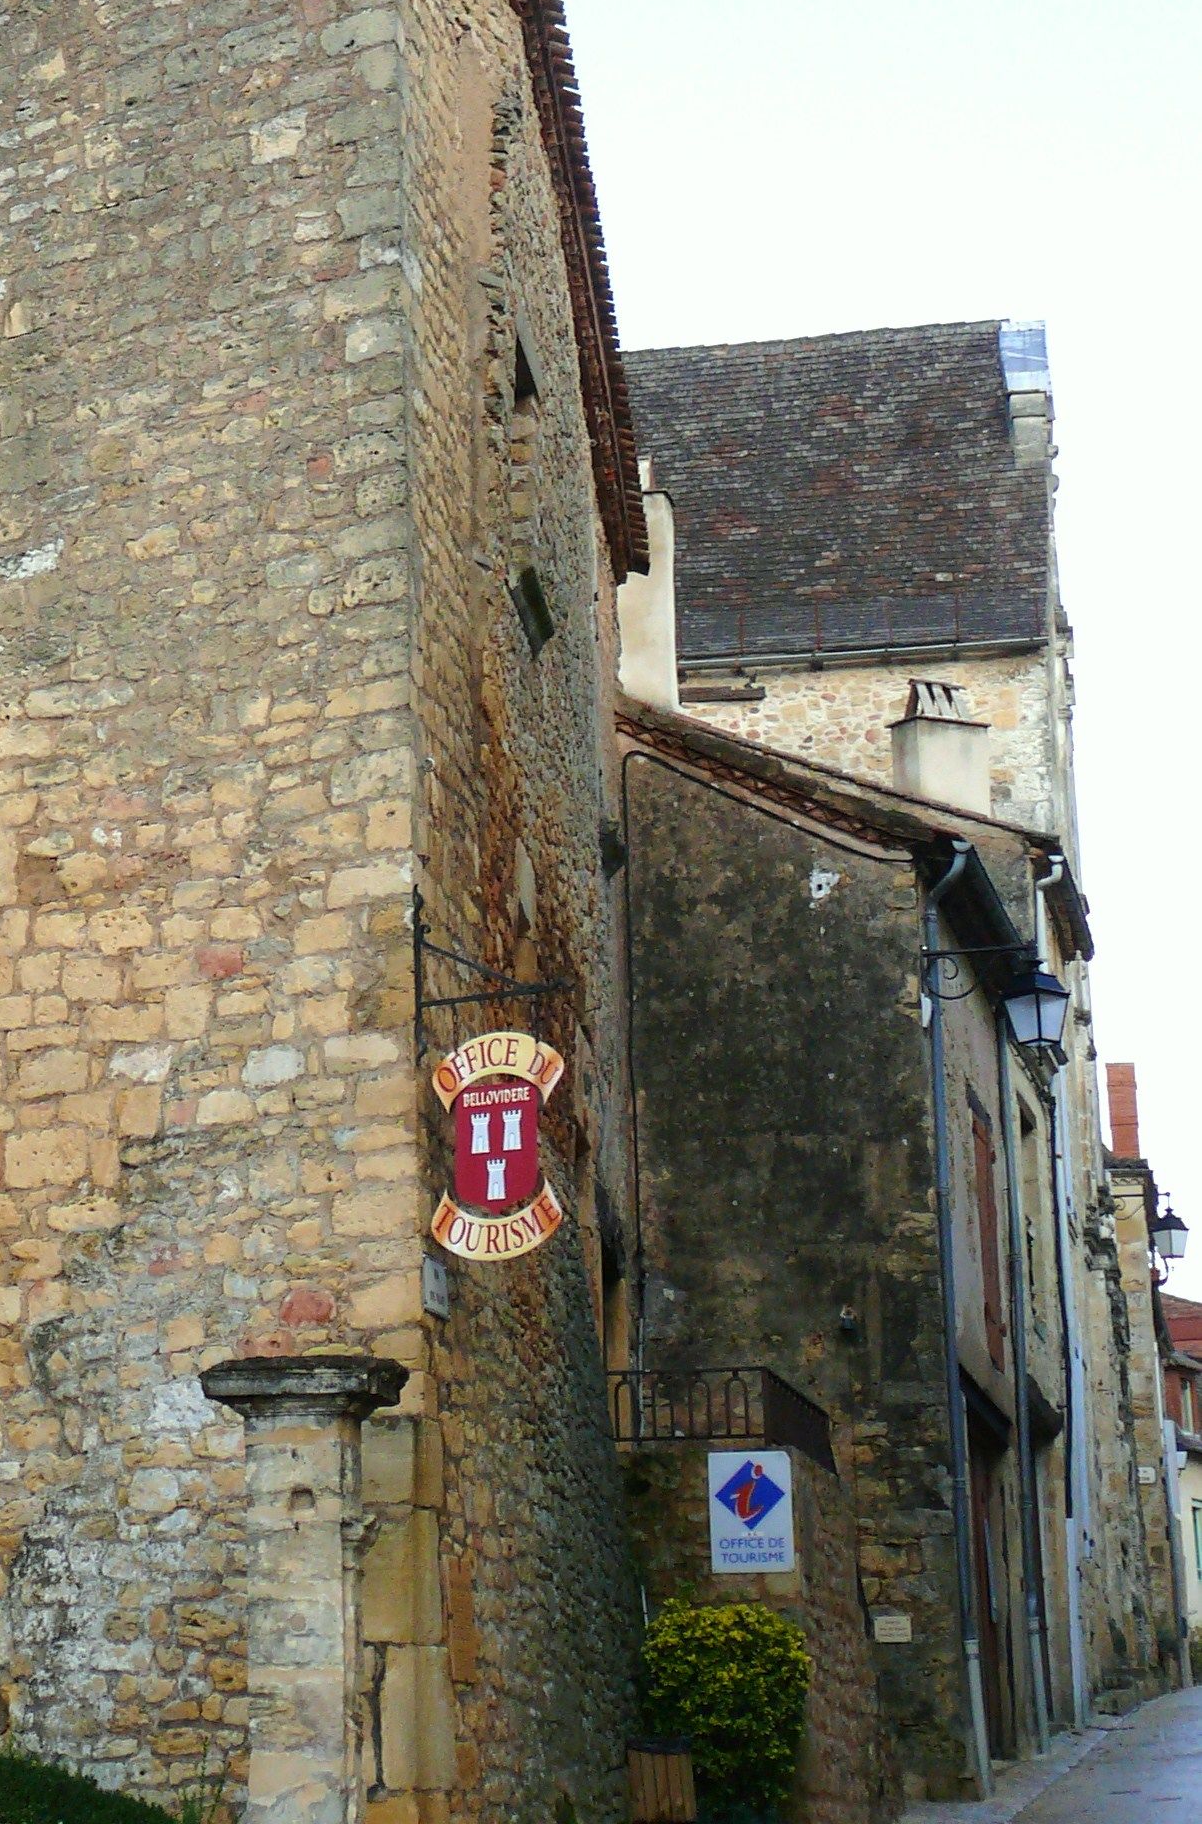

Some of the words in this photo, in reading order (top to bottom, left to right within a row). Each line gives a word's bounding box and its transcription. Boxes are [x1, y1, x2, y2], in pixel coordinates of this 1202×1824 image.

[438, 1038, 519, 1093] OFFICE
[527, 1050, 559, 1084] DU
[463, 1087, 530, 1107] BELLOVIDERE
[435, 1195, 560, 1254] TOURISME
[719, 1538, 764, 1549] OFFICE
[768, 1537, 785, 1548] DE
[720, 1552, 785, 1564] TOURISME
